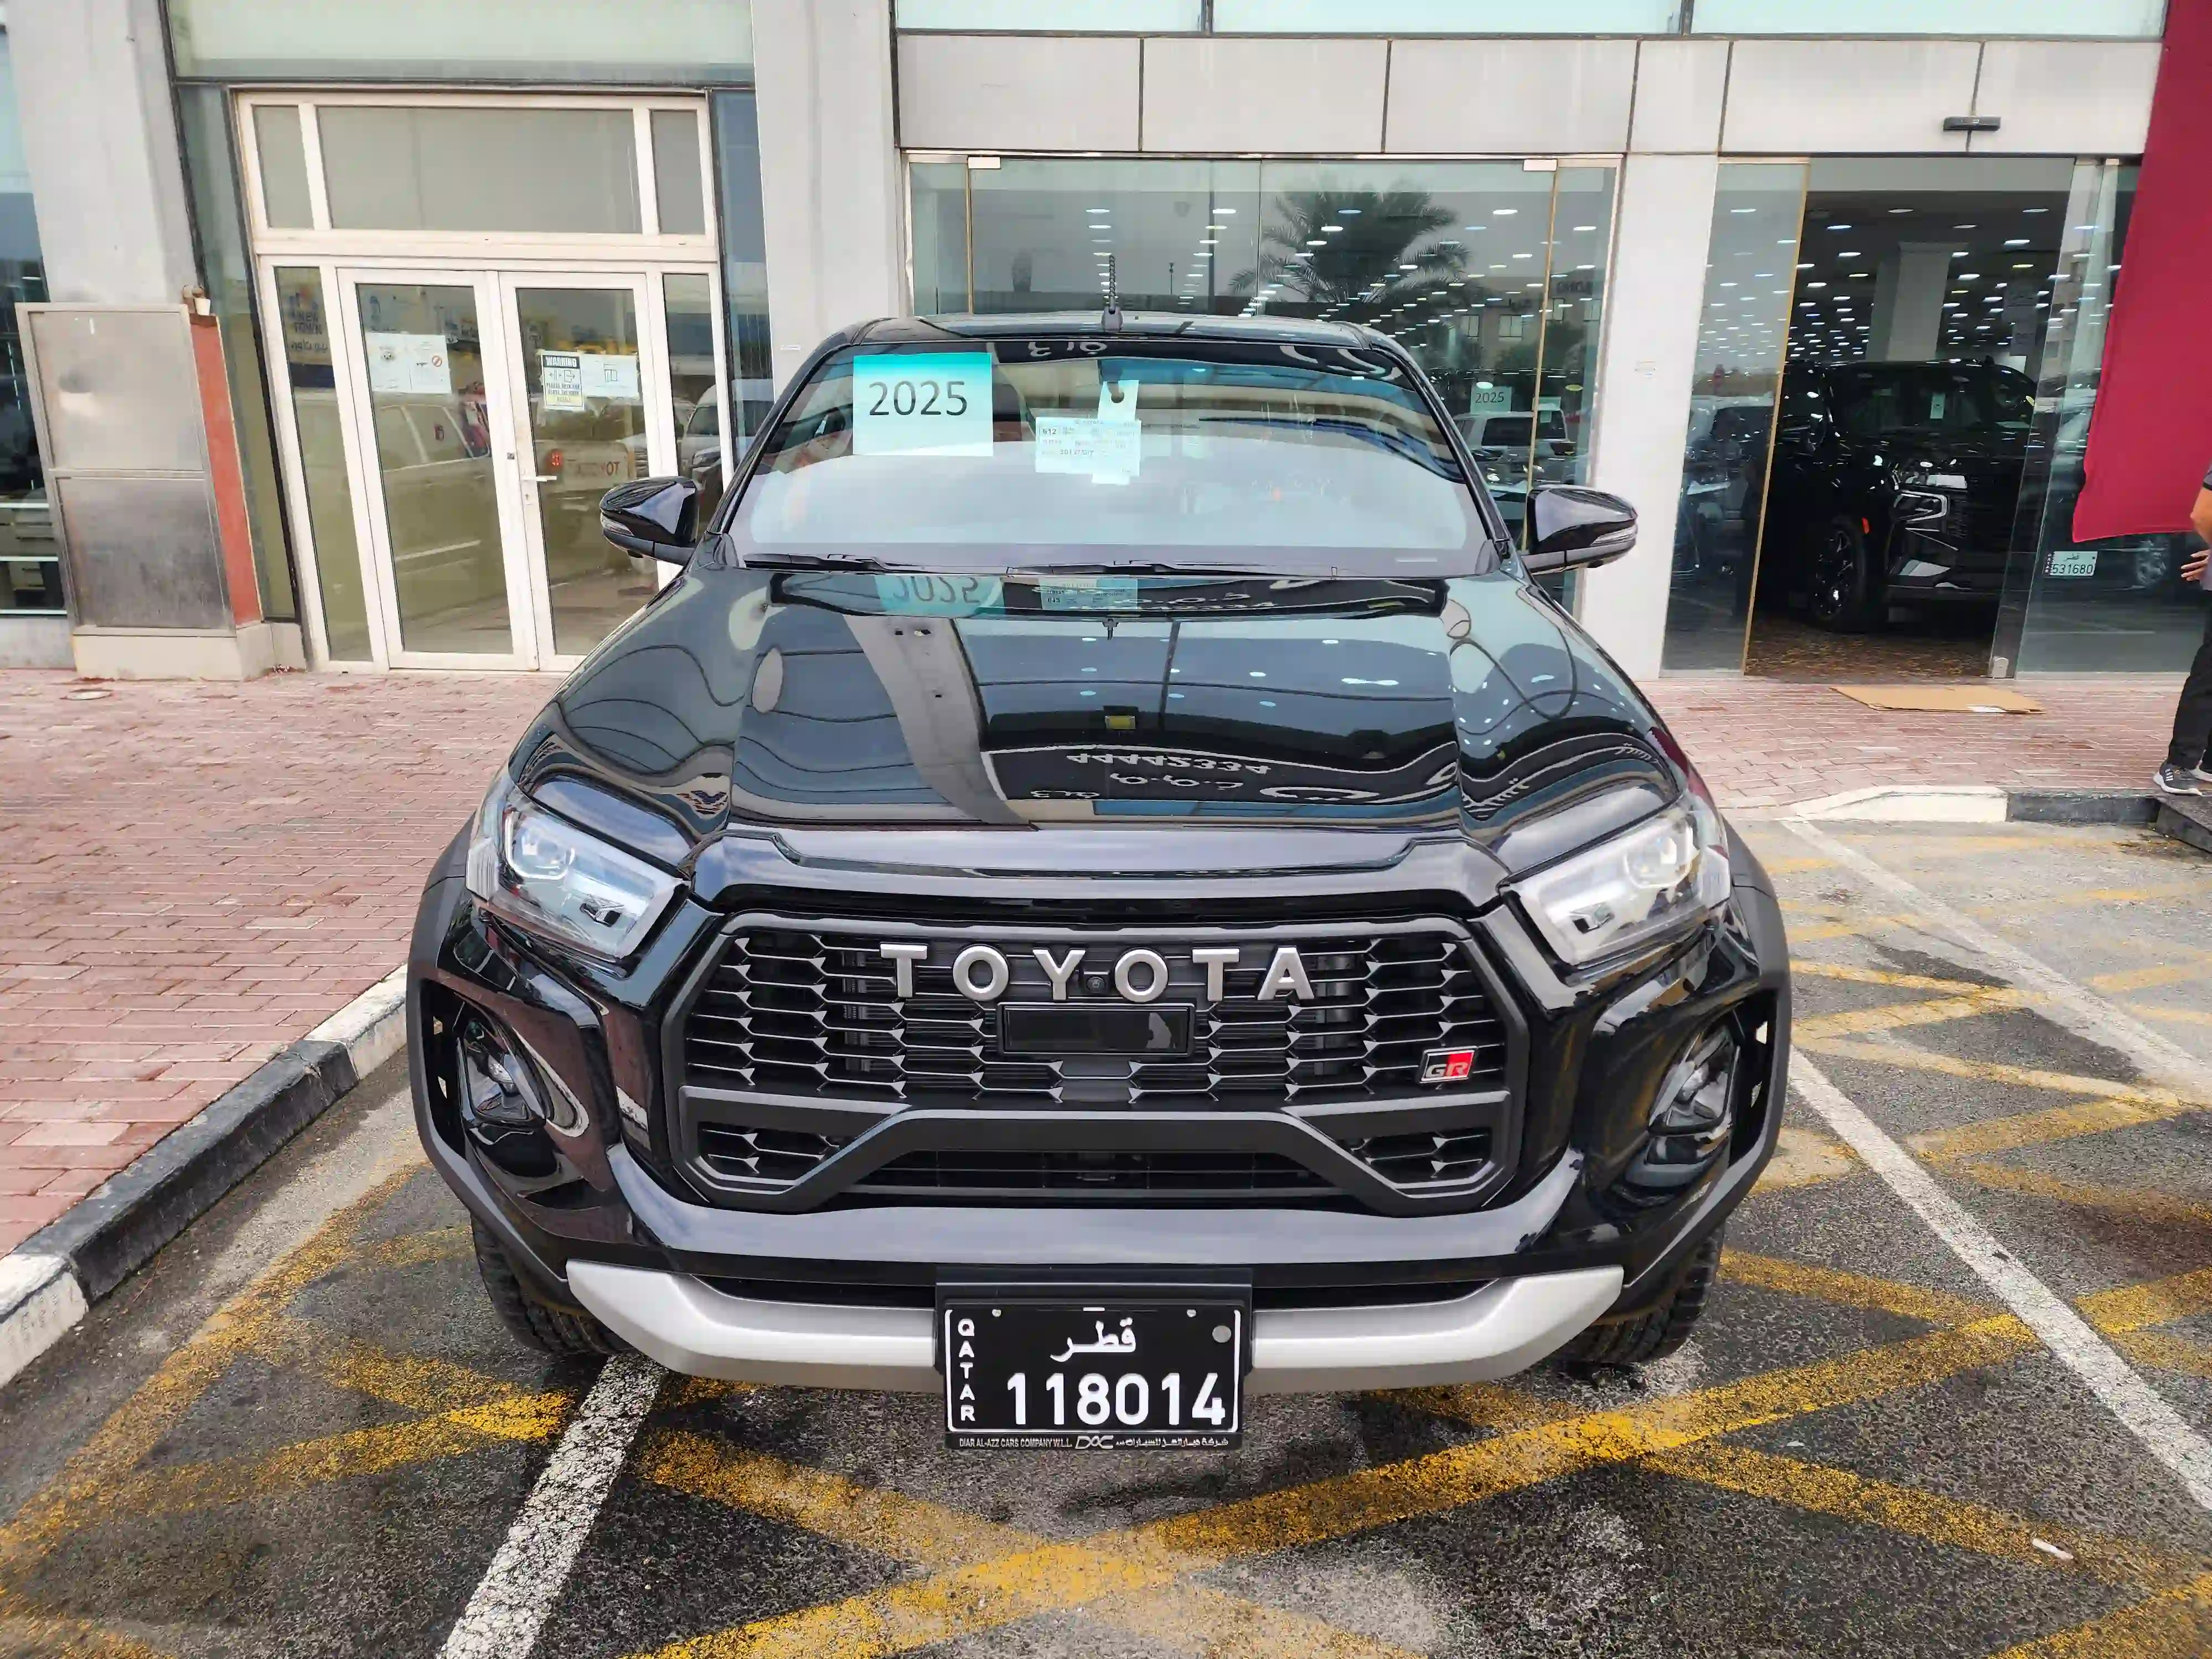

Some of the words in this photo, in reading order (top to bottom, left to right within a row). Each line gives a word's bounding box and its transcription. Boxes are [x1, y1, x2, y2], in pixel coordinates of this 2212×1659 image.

[869, 380, 967, 415] 2025
[1475, 392, 1504, 403] 2025
[2052, 564, 2094, 574] 531680
[880, 942, 1315, 1002] TOYOTA
[1425, 1062, 1469, 1078] GR
[1050, 1317, 1136, 1362] قطر
[958, 1319, 976, 1422] QATAR
[1007, 1373, 1226, 1425] 118014
[959, 1438, 975, 1447] DIAR
[1000, 1438, 1019, 1448] CARS
[1020, 1438, 1052, 1448] COMPANY
